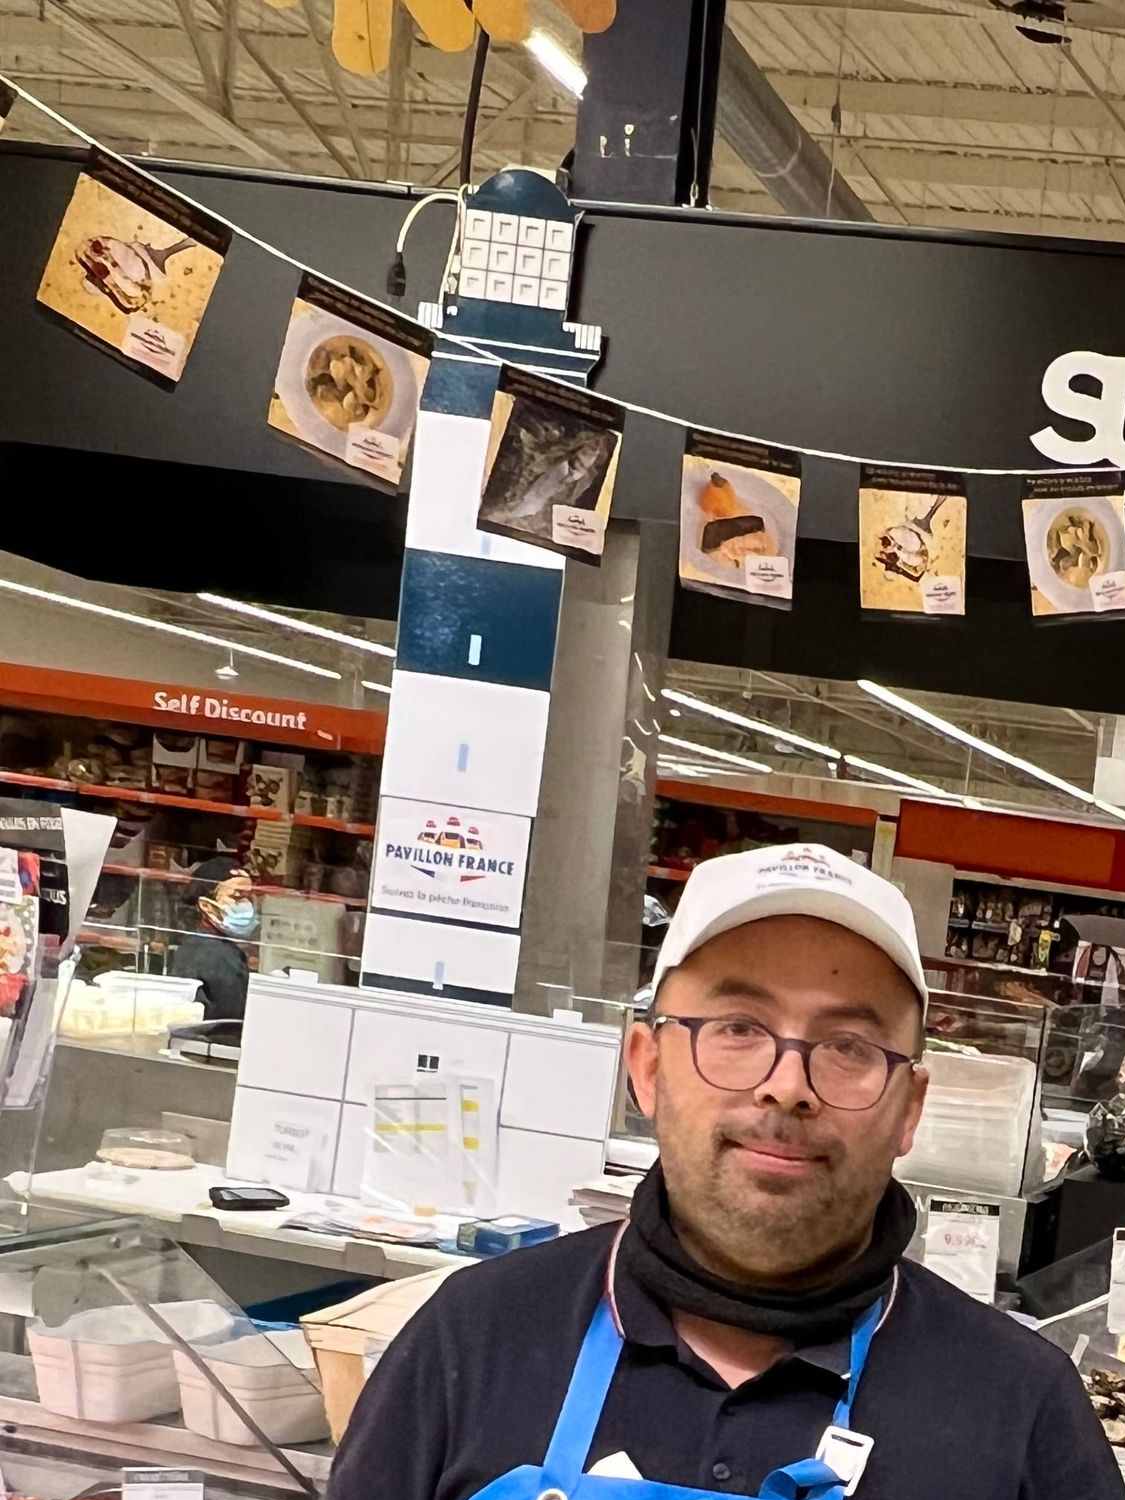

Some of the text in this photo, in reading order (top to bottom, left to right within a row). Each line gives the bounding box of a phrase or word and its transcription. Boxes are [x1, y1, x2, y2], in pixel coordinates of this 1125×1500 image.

[152, 691, 308, 730] Self Discount
[385, 843, 516, 876] PAVILLON FRANCE
